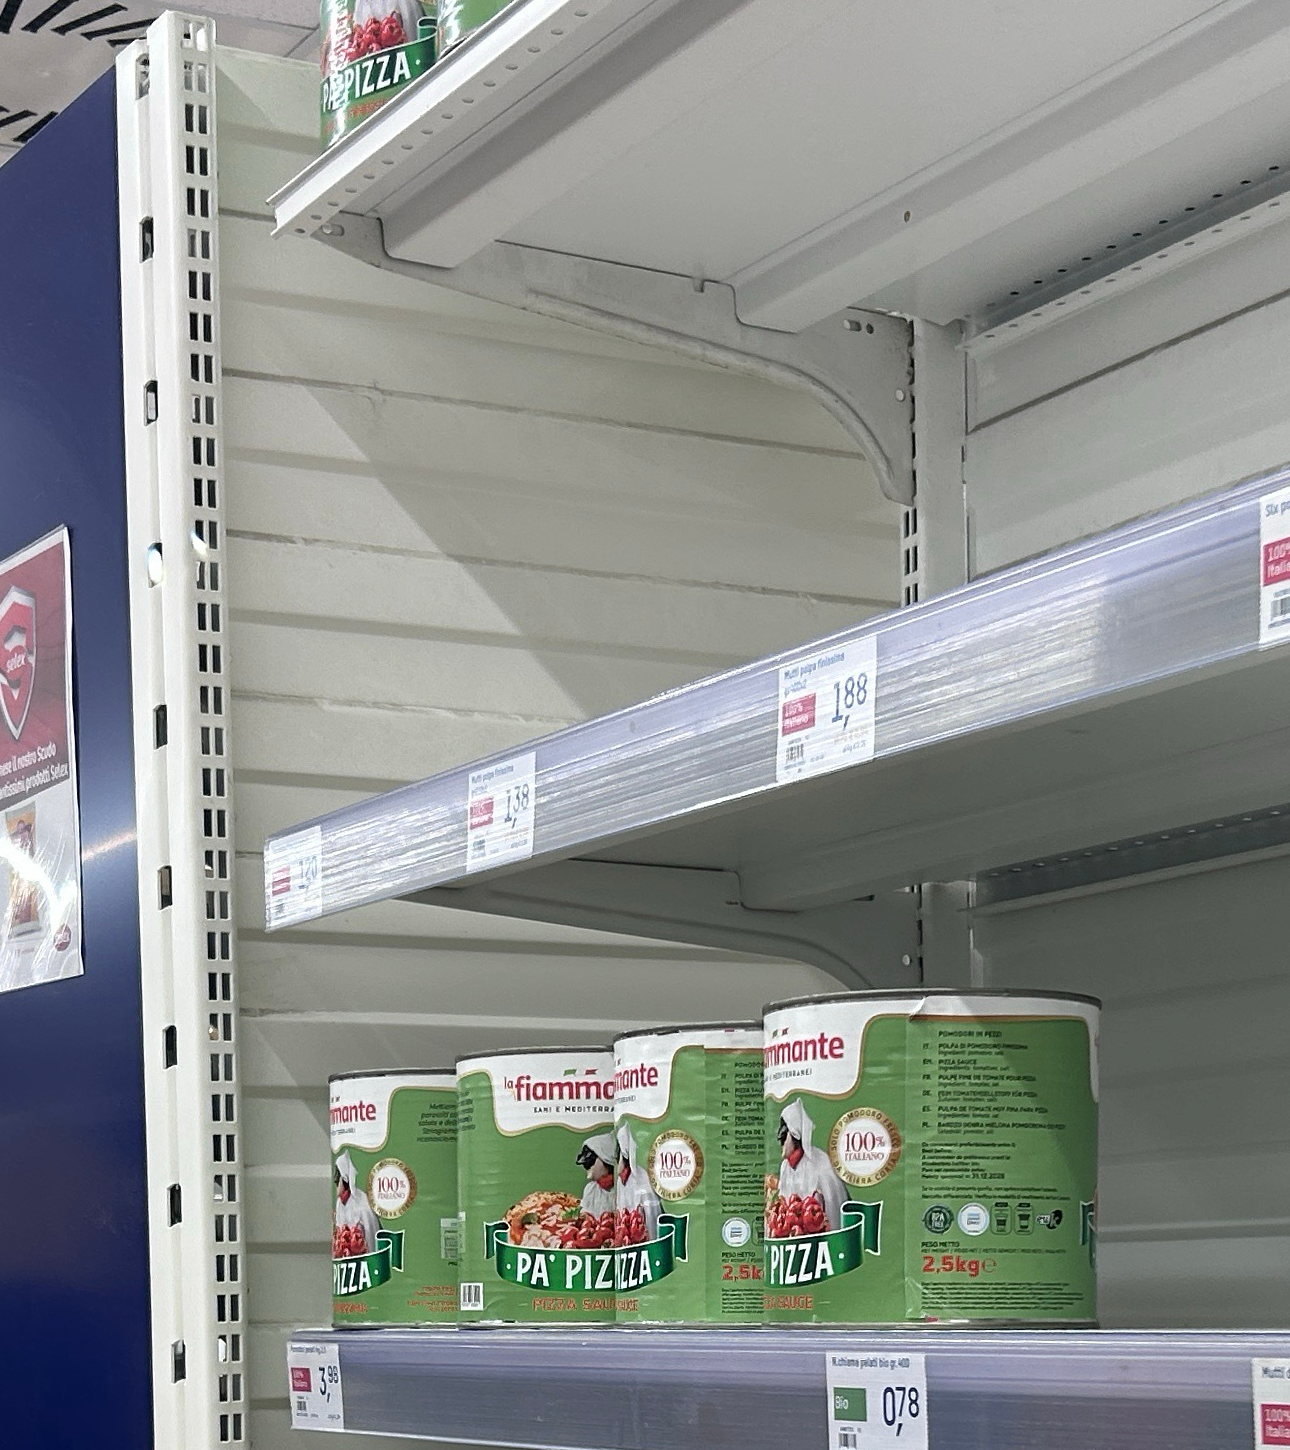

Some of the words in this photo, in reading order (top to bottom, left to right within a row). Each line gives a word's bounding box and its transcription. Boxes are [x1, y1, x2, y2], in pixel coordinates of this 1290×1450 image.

[345, 51, 411, 99] PIZZA
[504, 1077, 513, 1090] la
[845, 1132, 885, 1151] 100%
[660, 1152, 691, 1169] 100%
[845, 1151, 884, 1161] ITALIANO
[377, 1177, 406, 1193] 100%
[771, 1241, 835, 1286] PIZZA
[922, 1255, 980, 1277] 2,5kg
[883, 1387, 919, 1436] 0,78
